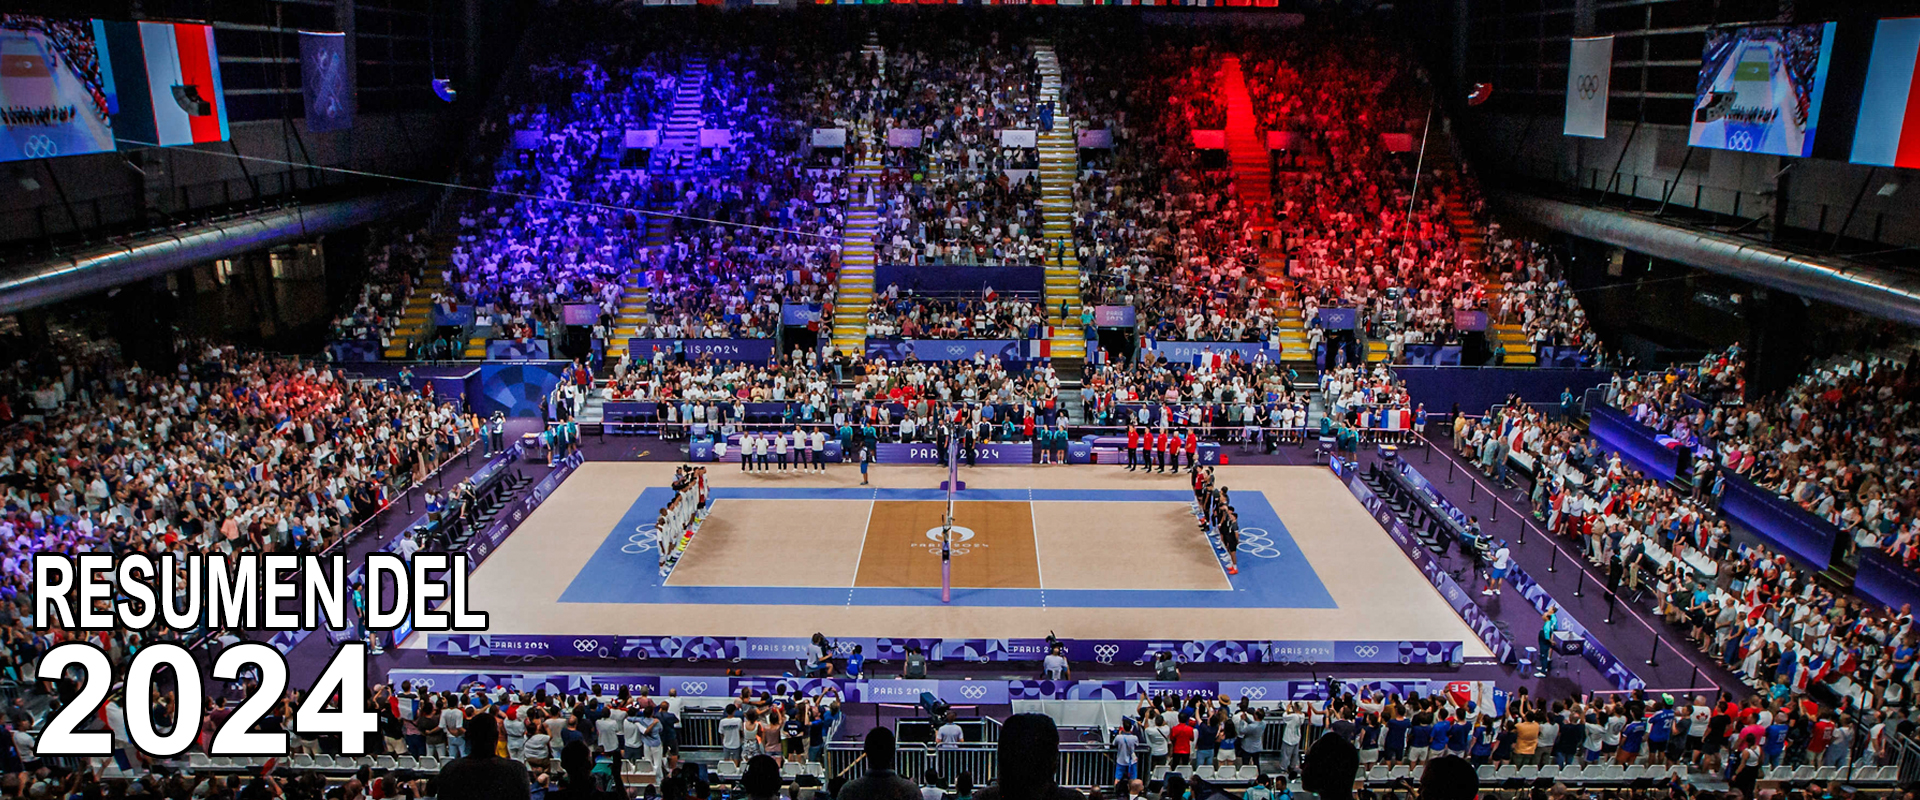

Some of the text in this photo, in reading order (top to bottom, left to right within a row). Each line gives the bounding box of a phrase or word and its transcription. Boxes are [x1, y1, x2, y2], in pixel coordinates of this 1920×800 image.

[705, 345, 738, 354] 2024
[910, 448, 939, 459] PAR
[495, 641, 549, 650] PARIS 2024
[751, 644, 807, 652] PARIS 2024
[1013, 646, 1041, 654] PARIS
[1274, 647, 1330, 655] PARIS 2024
[873, 687, 904, 695] PARIS
